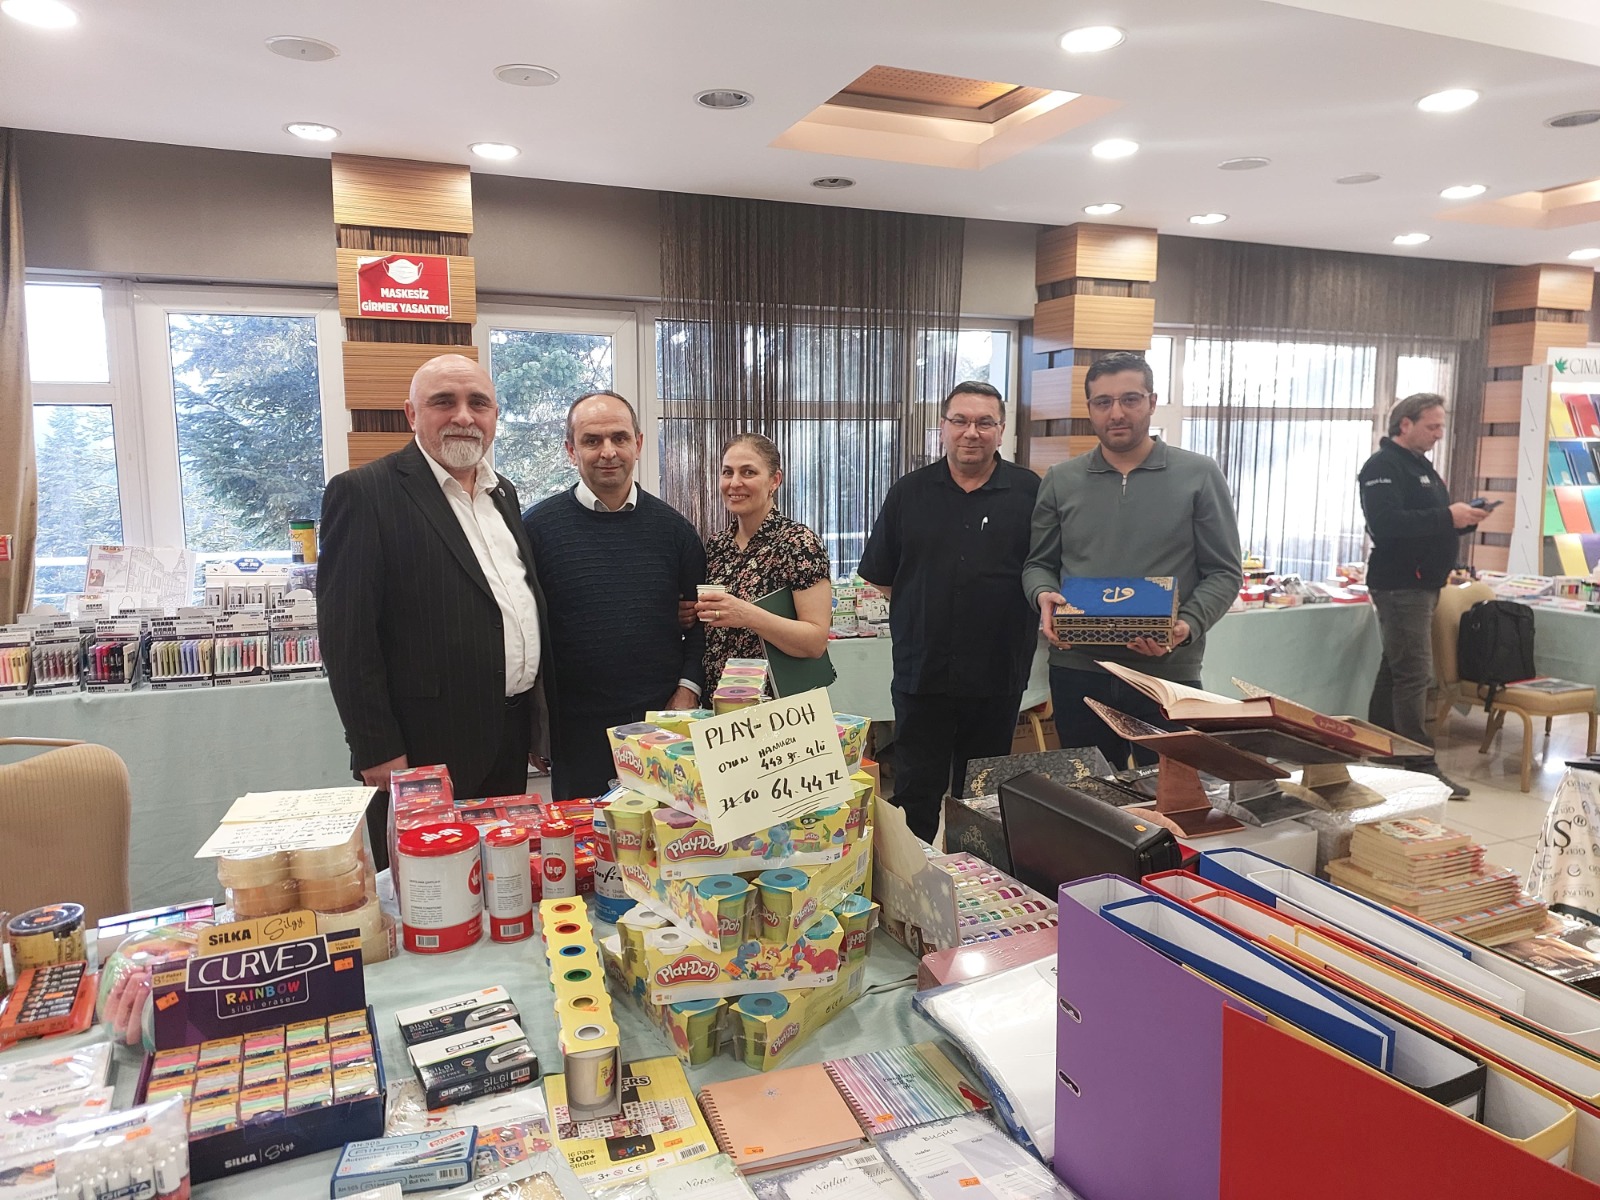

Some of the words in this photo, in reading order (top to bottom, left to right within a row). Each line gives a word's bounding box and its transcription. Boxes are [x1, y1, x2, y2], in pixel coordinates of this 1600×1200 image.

[380, 287, 430, 300] MASKESİZ
[361, 300, 398, 313] GİRMEK
[399, 302, 449, 315] YASAKTIR!
[769, 703, 816, 732] DOH
[760, 755, 783, 771] 448
[198, 942, 318, 985] CURVED
[659, 960, 717, 983] Play-Doh
[225, 980, 300, 1005] RAINBOW
[261, 995, 297, 1009] eraser
[483, 1082, 510, 1094] ERASER
[922, 1128, 958, 1142] BUGÜN
[569, 1154, 596, 1164] 300+
[570, 1160, 597, 1170] Sticker
[597, 1173, 611, 1181] 3+
